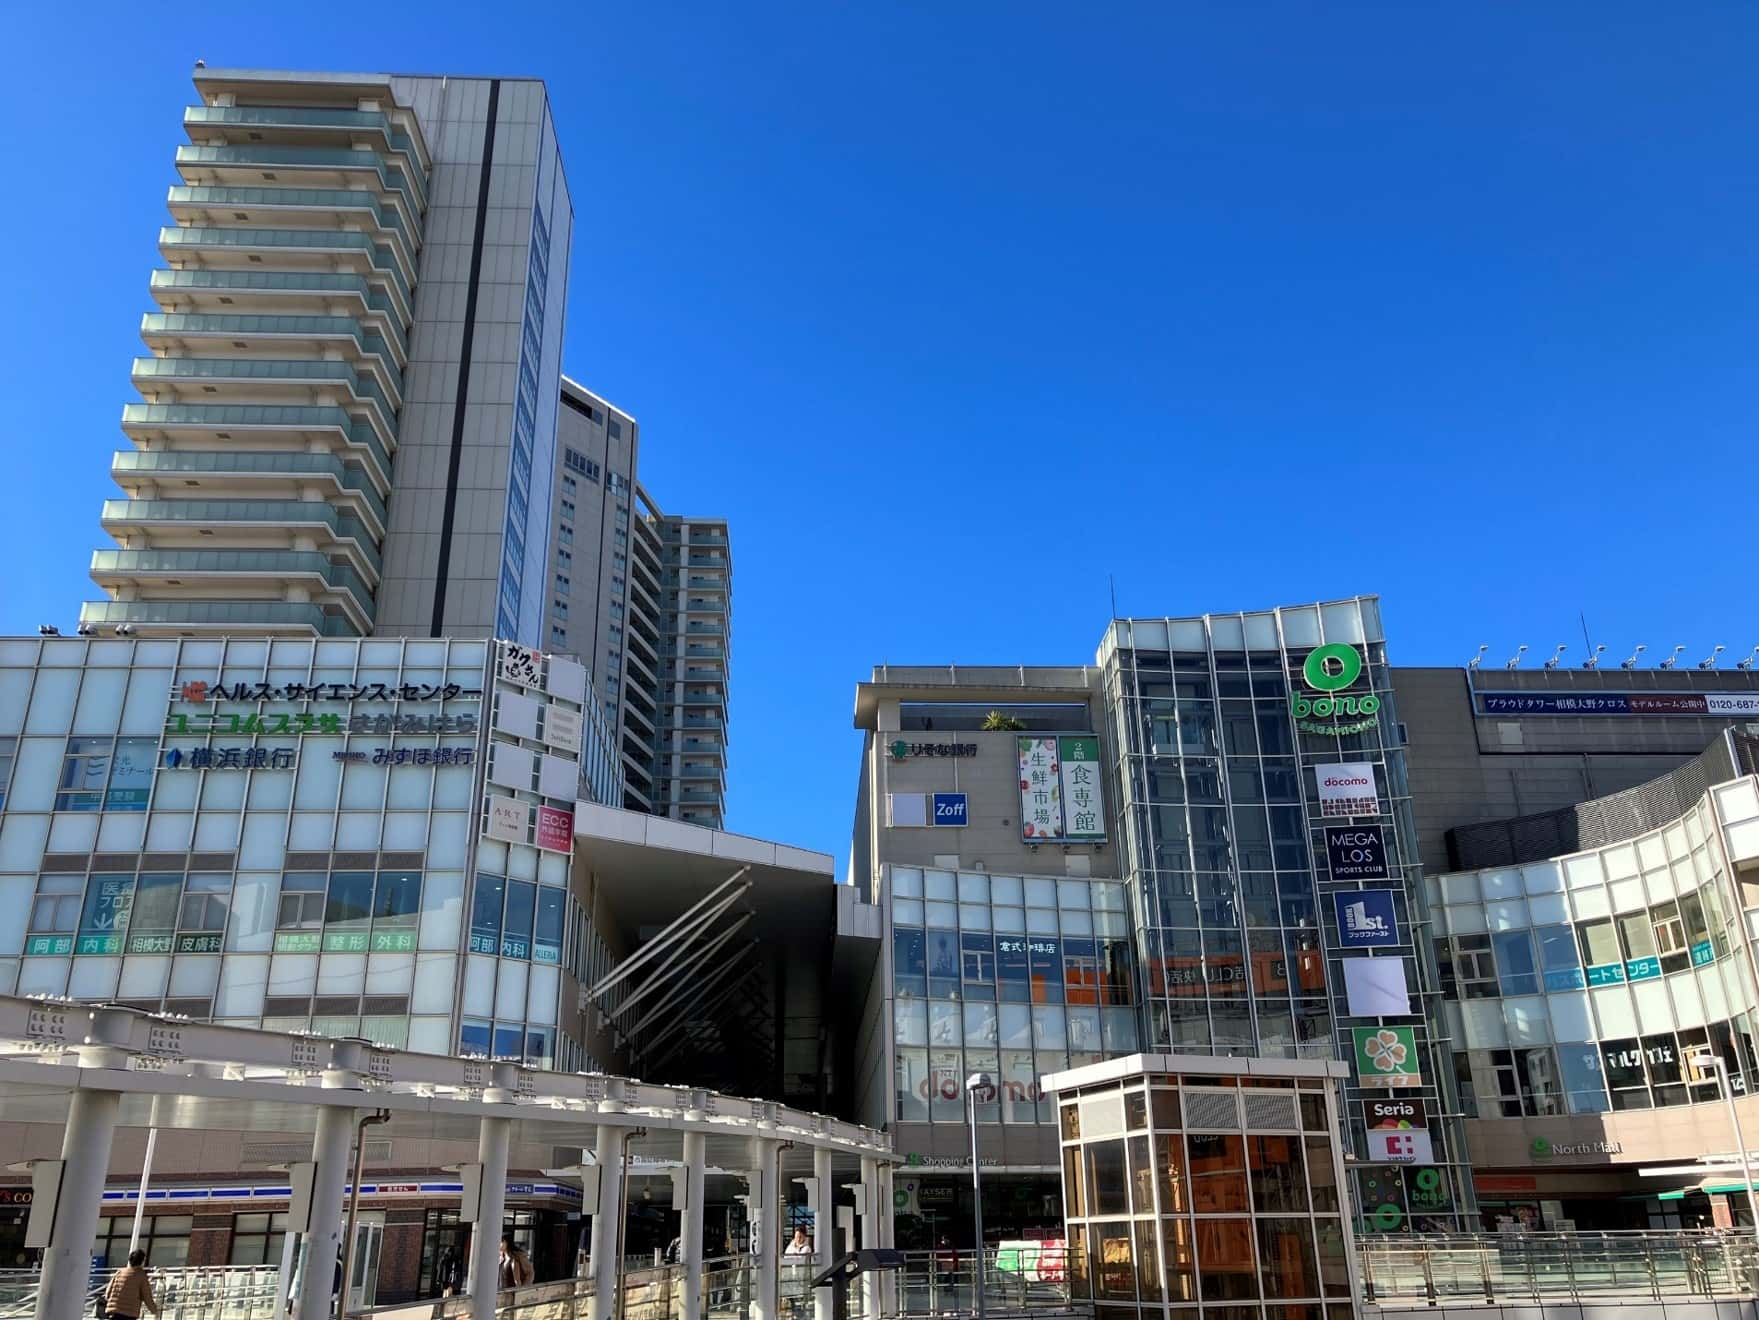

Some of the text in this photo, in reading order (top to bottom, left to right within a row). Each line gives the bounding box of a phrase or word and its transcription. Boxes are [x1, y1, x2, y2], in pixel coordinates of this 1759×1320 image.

[210, 682, 482, 701] ヘルス・サイエンス・センター
[1291, 690, 1380, 719] bono
[190, 747, 295, 769] 横浜銀行
[372, 748, 473, 766] みずほ銀行
[1031, 751, 1051, 825] 生鮮市場
[1324, 776, 1368, 788] docomo
[1071, 763, 1096, 831] 食専館
[936, 803, 964, 817] Zoff
[542, 812, 569, 829] ECC
[1331, 832, 1379, 847] MEGA
[1341, 848, 1374, 863] LOS
[1335, 866, 1363, 874] SPORTS
[1582, 1045, 1674, 1071] サマルクカフェ
[919, 1069, 1048, 1102] doomo
[1374, 1102, 1415, 1117] Seria
[1552, 1140, 1624, 1155] North Mall
[922, 1155, 999, 1170] Shopping Cnter
